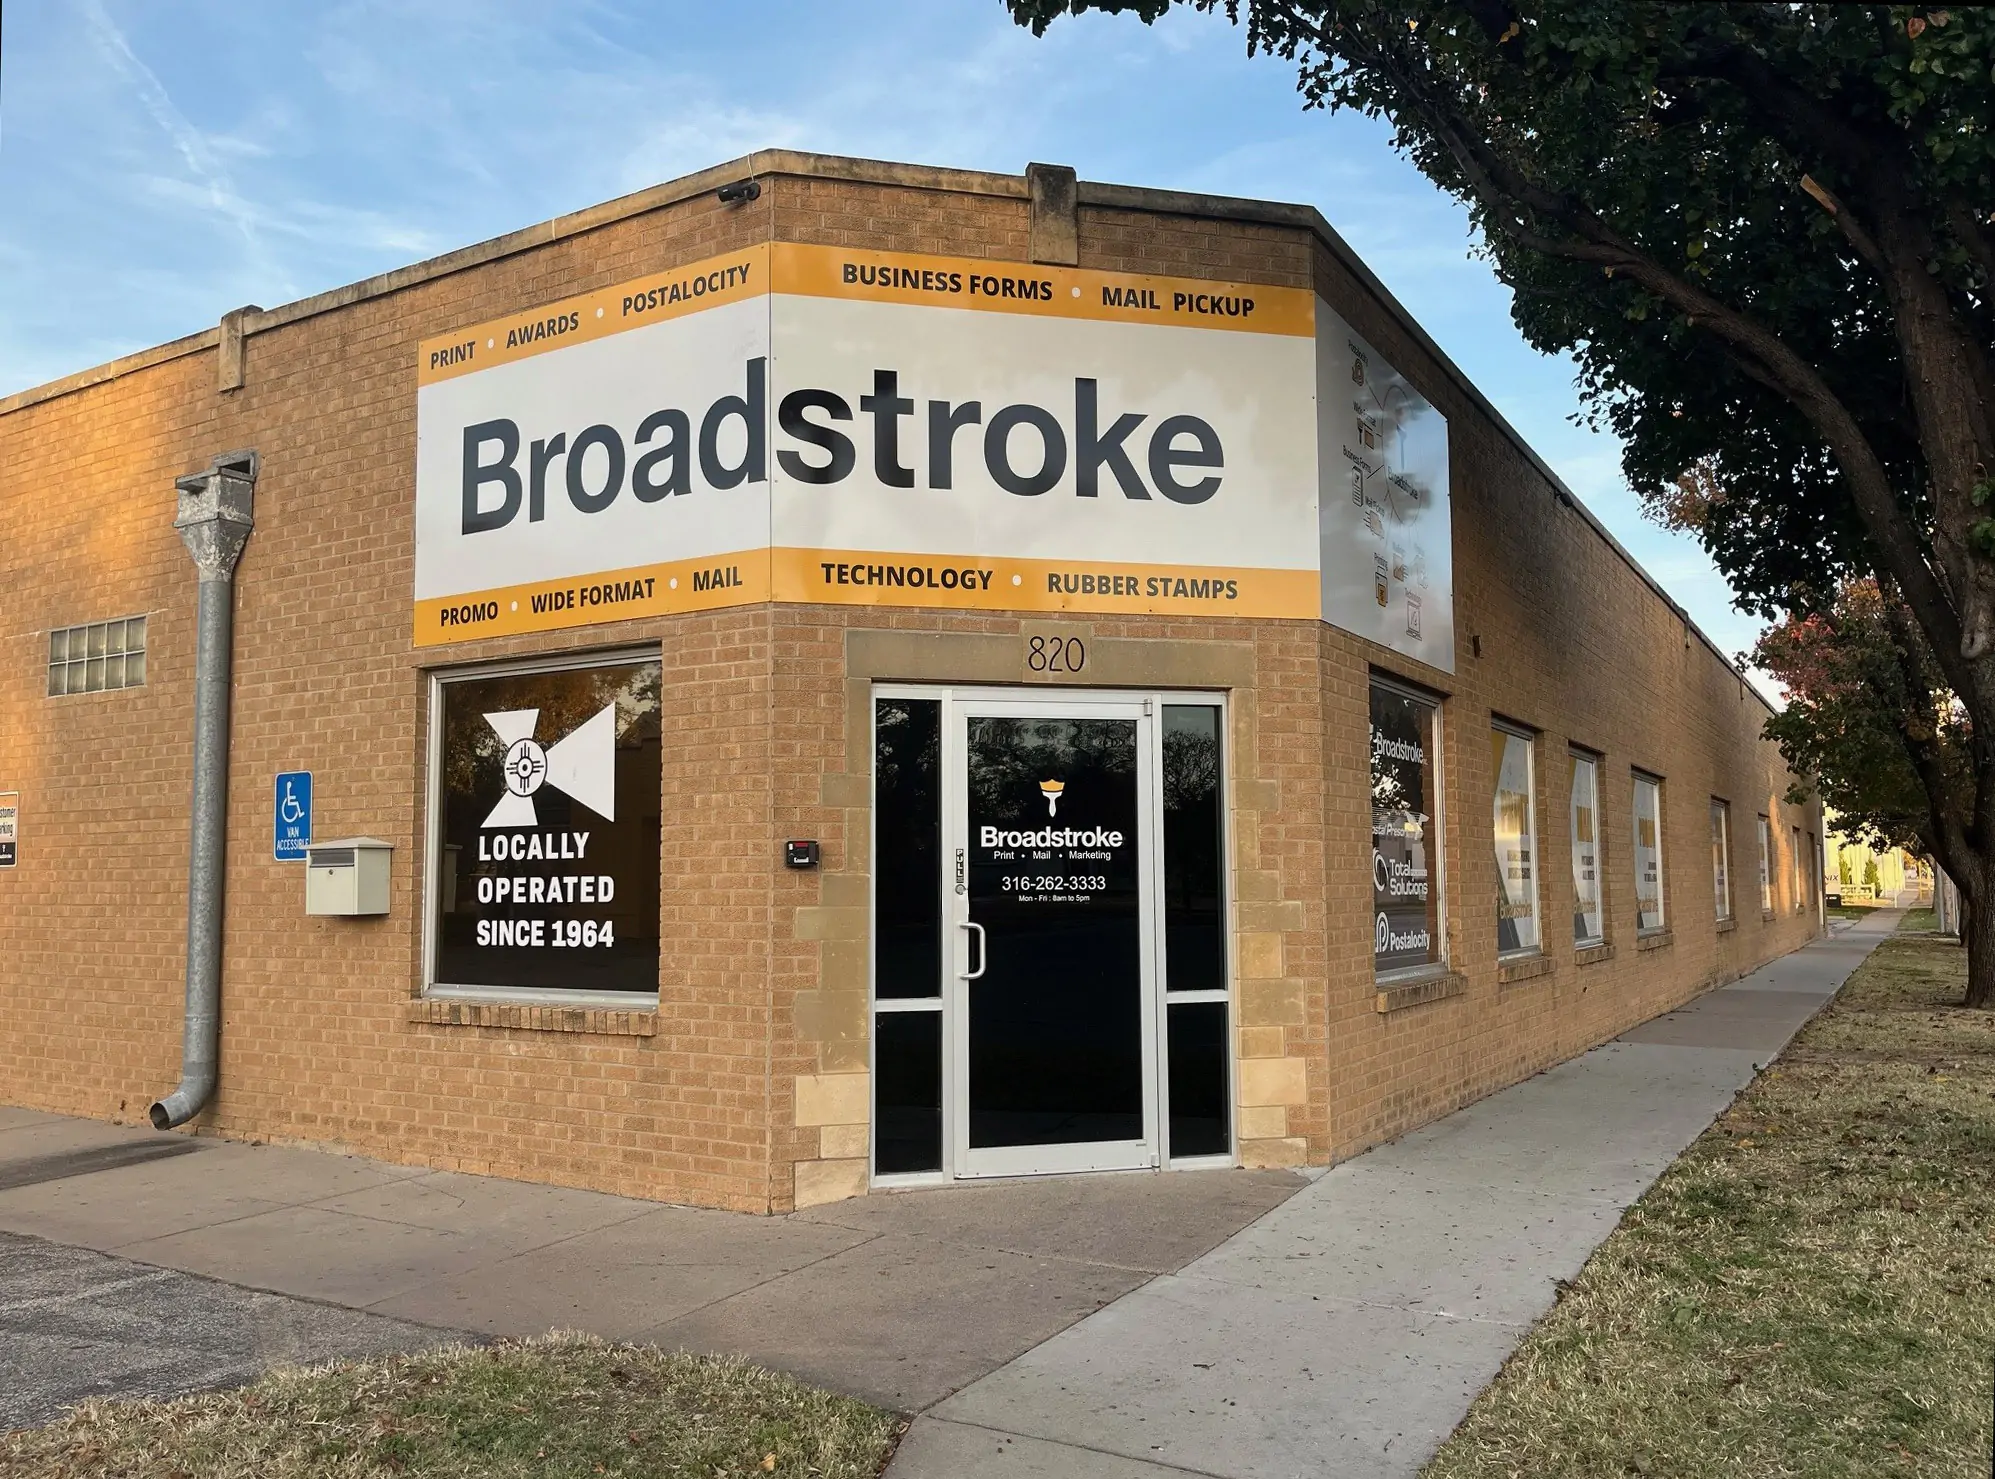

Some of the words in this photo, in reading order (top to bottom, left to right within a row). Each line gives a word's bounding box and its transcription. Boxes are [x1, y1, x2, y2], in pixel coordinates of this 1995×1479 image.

[843, 263, 961, 293] BUSINESS
[970, 275, 1053, 301] FORMS
[1102, 286, 1161, 310] MAIL
[1173, 292, 1255, 317] PICKUP
[430, 341, 475, 370] PRINT
[506, 312, 579, 348] AWARDS
[622, 263, 751, 316] POSTALOCITY
[461, 356, 1225, 535] Broadstroke
[821, 563, 993, 590] TECHNOLOGY
[1048, 573, 1139, 596] RUBBER
[1146, 577, 1238, 600] STAMPS
[440, 601, 499, 627] PROMO
[531, 585, 575, 614] WIDE
[579, 578, 655, 607] FORMAT
[693, 566, 743, 592] MAIL
[1028, 635, 1085, 673] 820
[1377, 731, 1424, 764] Broadstroke
[286, 826, 300, 838] VAN
[478, 832, 590, 861] LOCALLY
[980, 825, 1123, 848] Broadstroke
[956, 849, 964, 877] PULL
[993, 850, 1015, 860] Print
[1032, 850, 1051, 860] Mail
[1069, 850, 1112, 861] Marketing
[1389, 859, 1410, 876] Total
[477, 875, 615, 904] OPERATED
[1002, 876, 1106, 891] 316-262-3333
[1389, 877, 1428, 896] Solutions
[476, 919, 545, 947] SINCE
[551, 920, 615, 948] 1964
[1390, 929, 1431, 951] Postalocity
